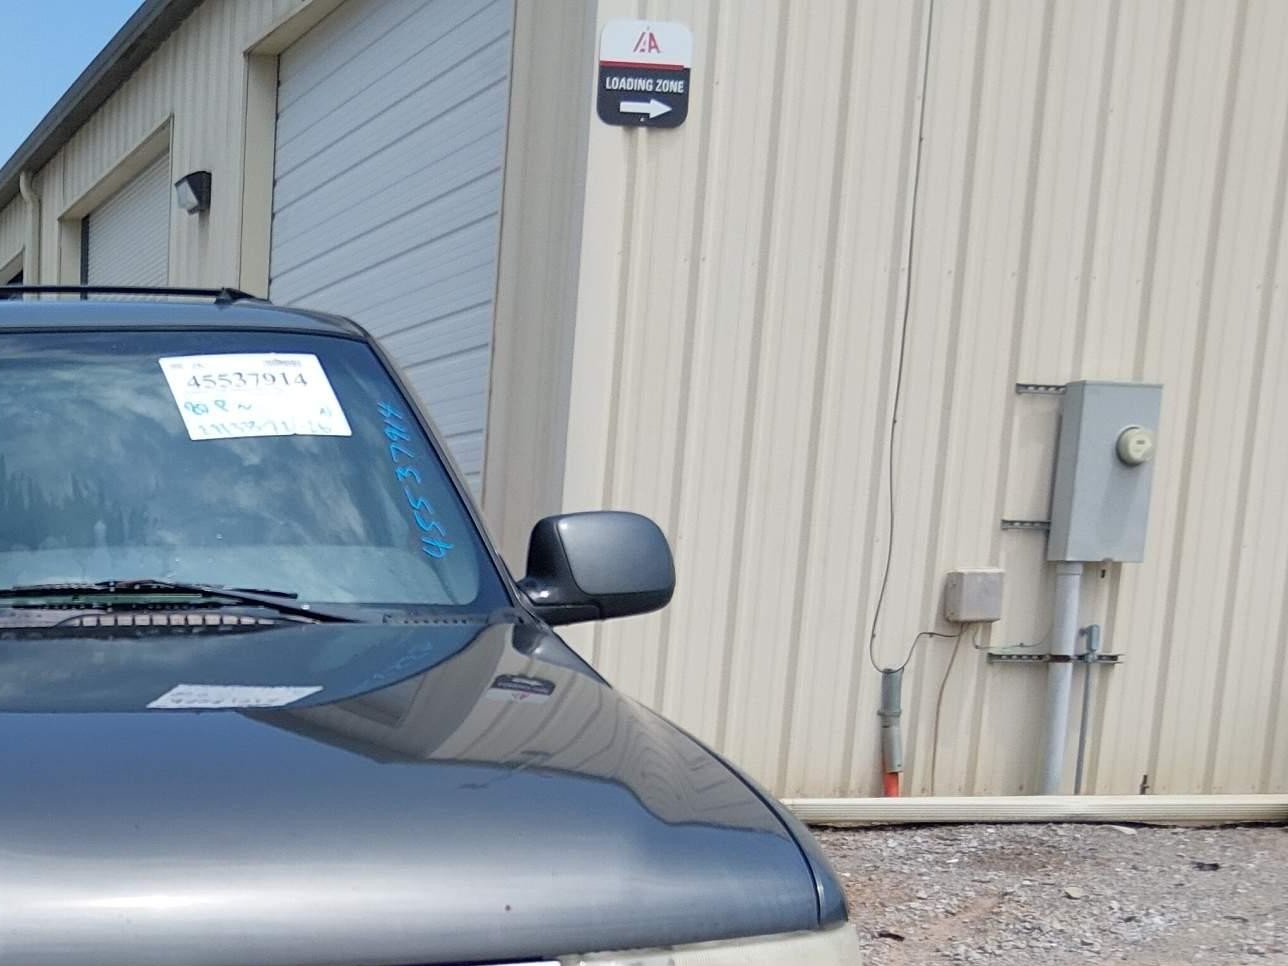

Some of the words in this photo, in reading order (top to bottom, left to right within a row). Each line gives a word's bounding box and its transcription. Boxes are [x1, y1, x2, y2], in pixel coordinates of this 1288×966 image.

[605, 76, 653, 92] LOADING
[655, 79, 684, 93] ZONE
[186, 371, 308, 389] 45537914
[376, 400, 455, 559] 45537914
